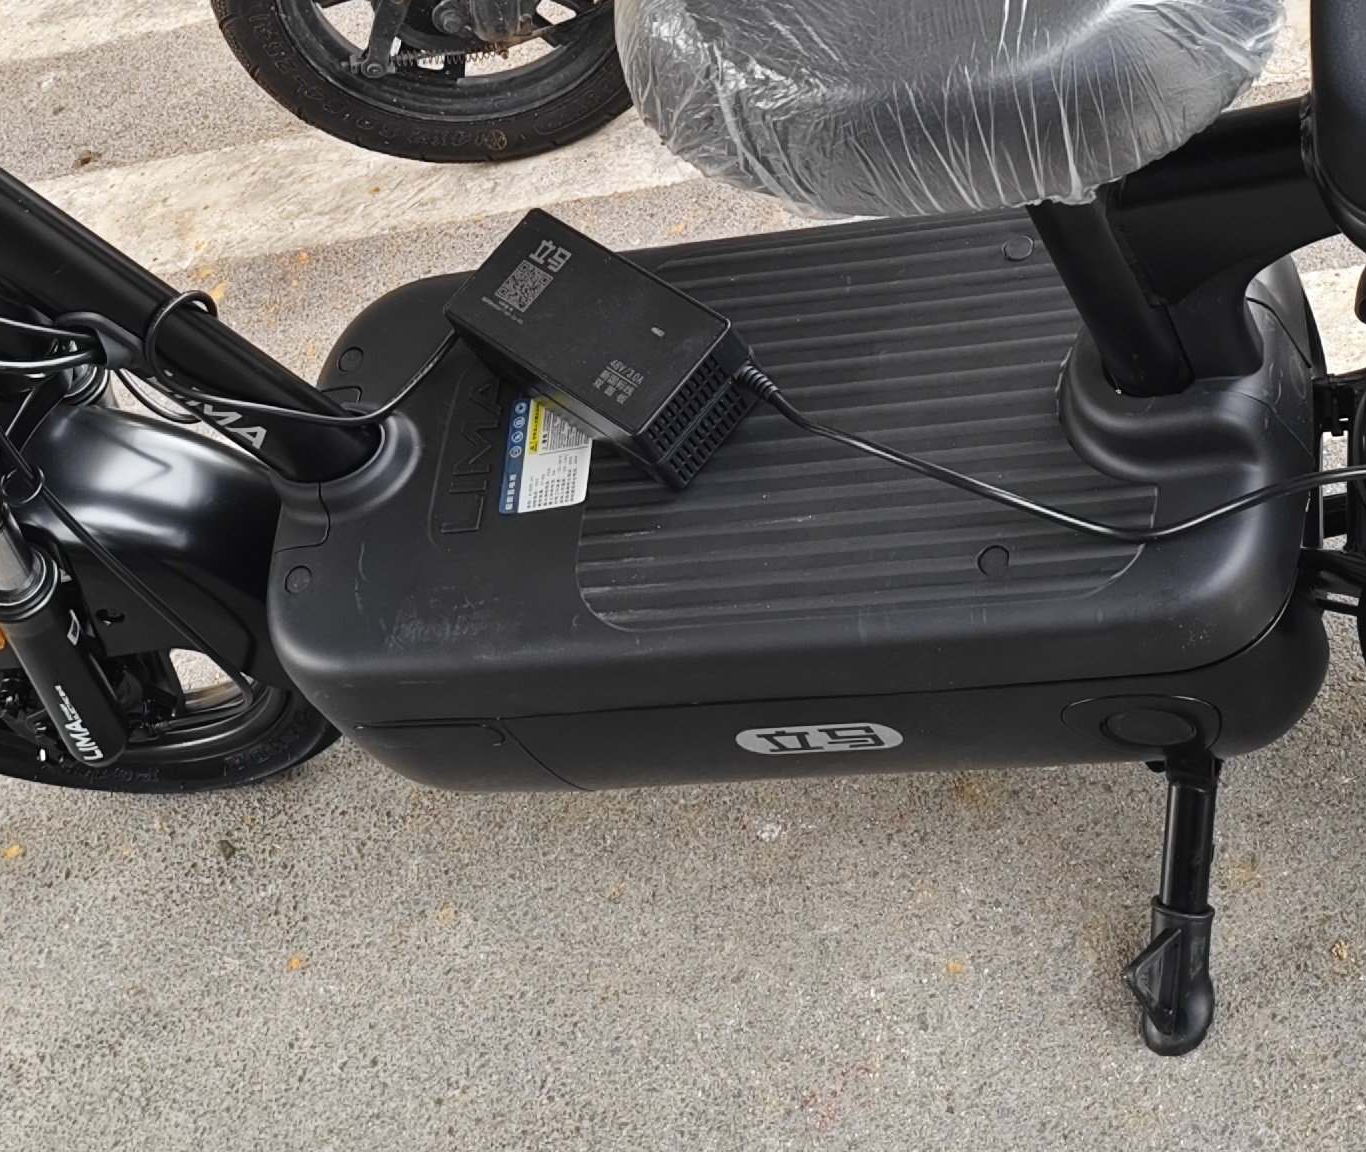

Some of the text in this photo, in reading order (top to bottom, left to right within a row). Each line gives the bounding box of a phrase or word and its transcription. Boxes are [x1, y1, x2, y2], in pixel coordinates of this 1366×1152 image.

[529, 239, 572, 273] 立马
[440, 376, 504, 534] LIMA
[64, 718, 104, 761] LIMA
[752, 726, 889, 753] 立马
